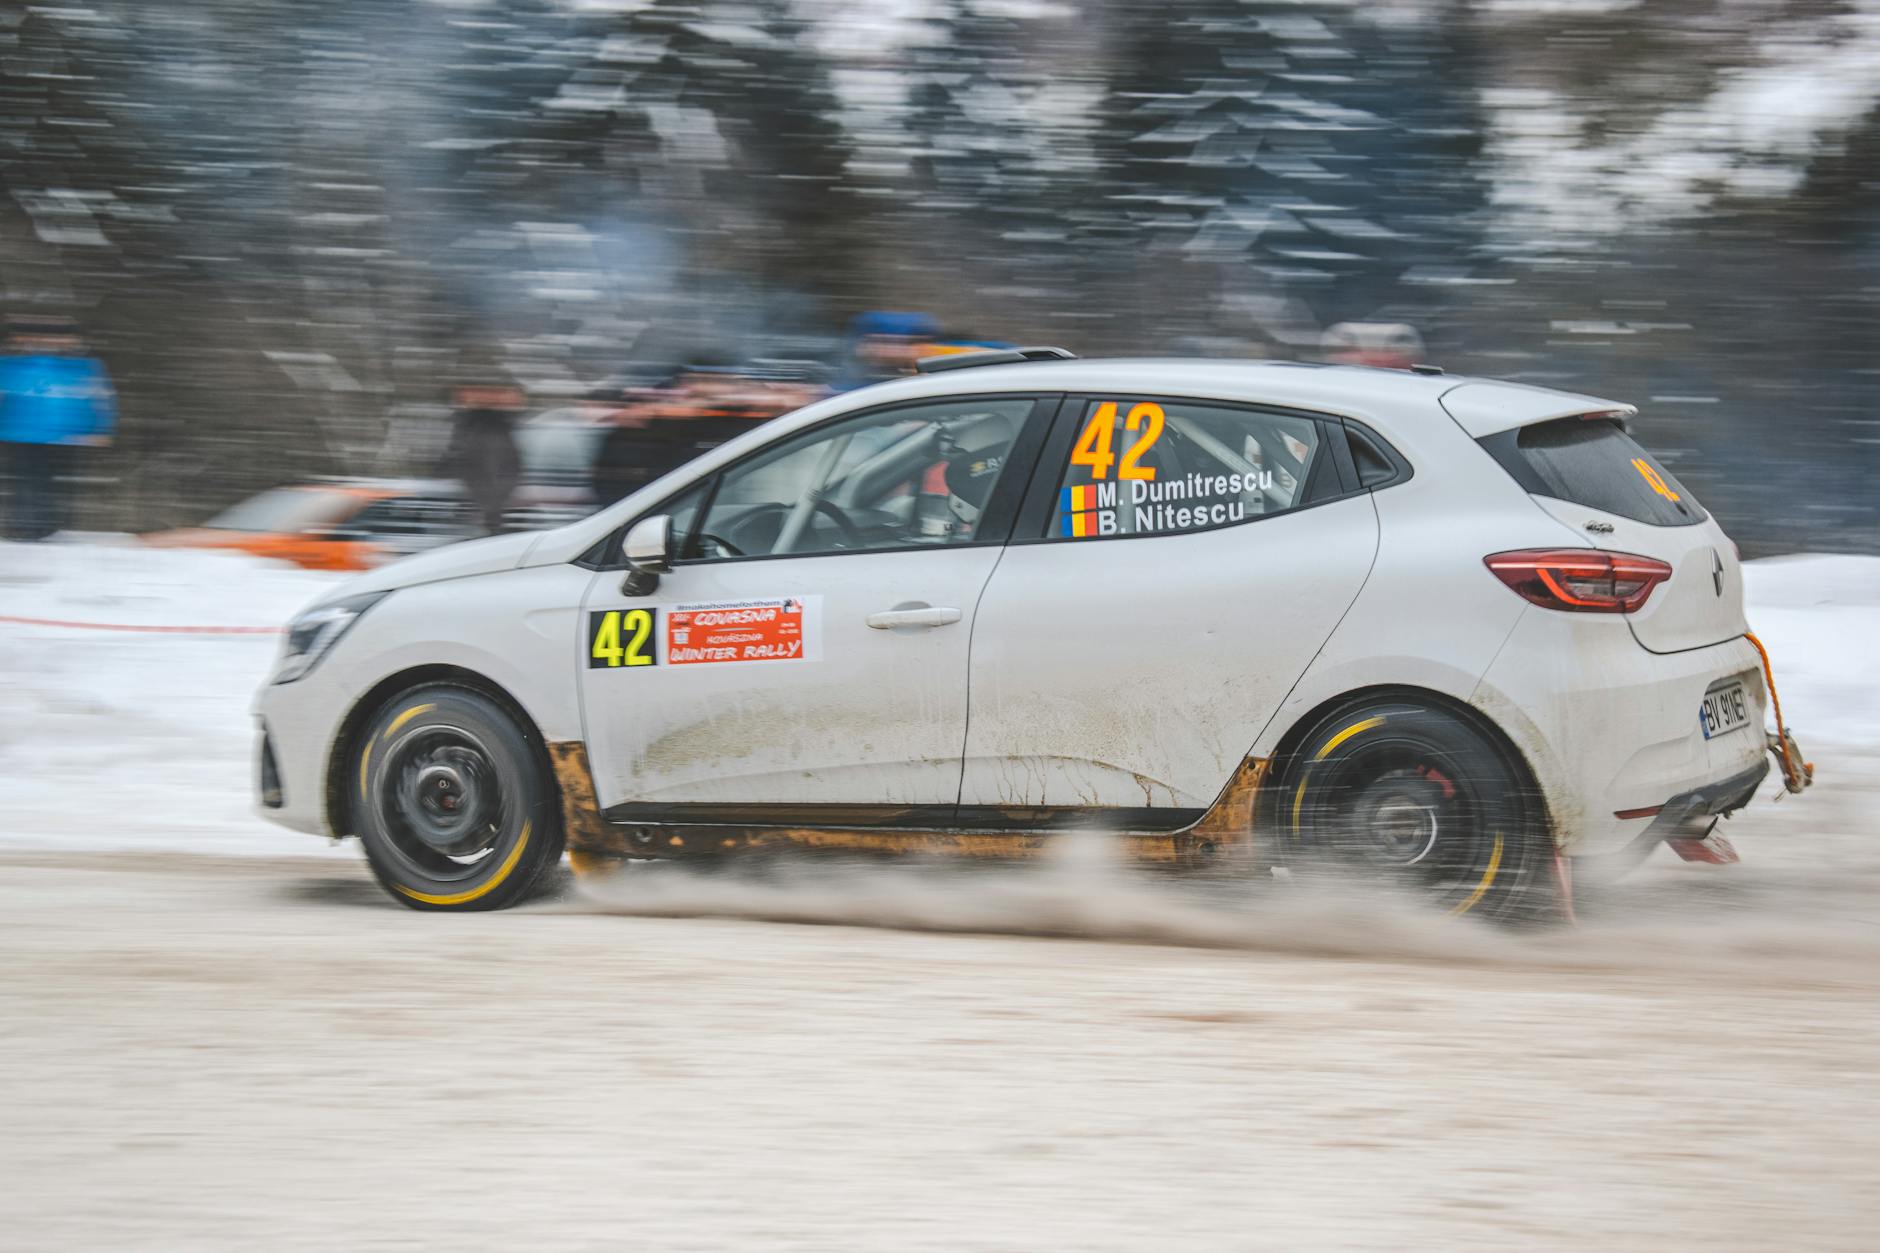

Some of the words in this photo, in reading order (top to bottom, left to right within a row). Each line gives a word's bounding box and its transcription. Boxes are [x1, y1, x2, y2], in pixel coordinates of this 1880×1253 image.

[1071, 401, 1165, 481] 42
[1097, 481, 1124, 508] M.
[1131, 470, 1273, 505] Dumitrescu
[1098, 510, 1127, 536] B.
[1135, 501, 1245, 532] Nitescu
[693, 609, 777, 626] COVASNA
[592, 609, 652, 667] 42
[671, 646, 738, 662] WINTER
[743, 640, 801, 658] RALLY
[1703, 696, 1721, 732] BV
